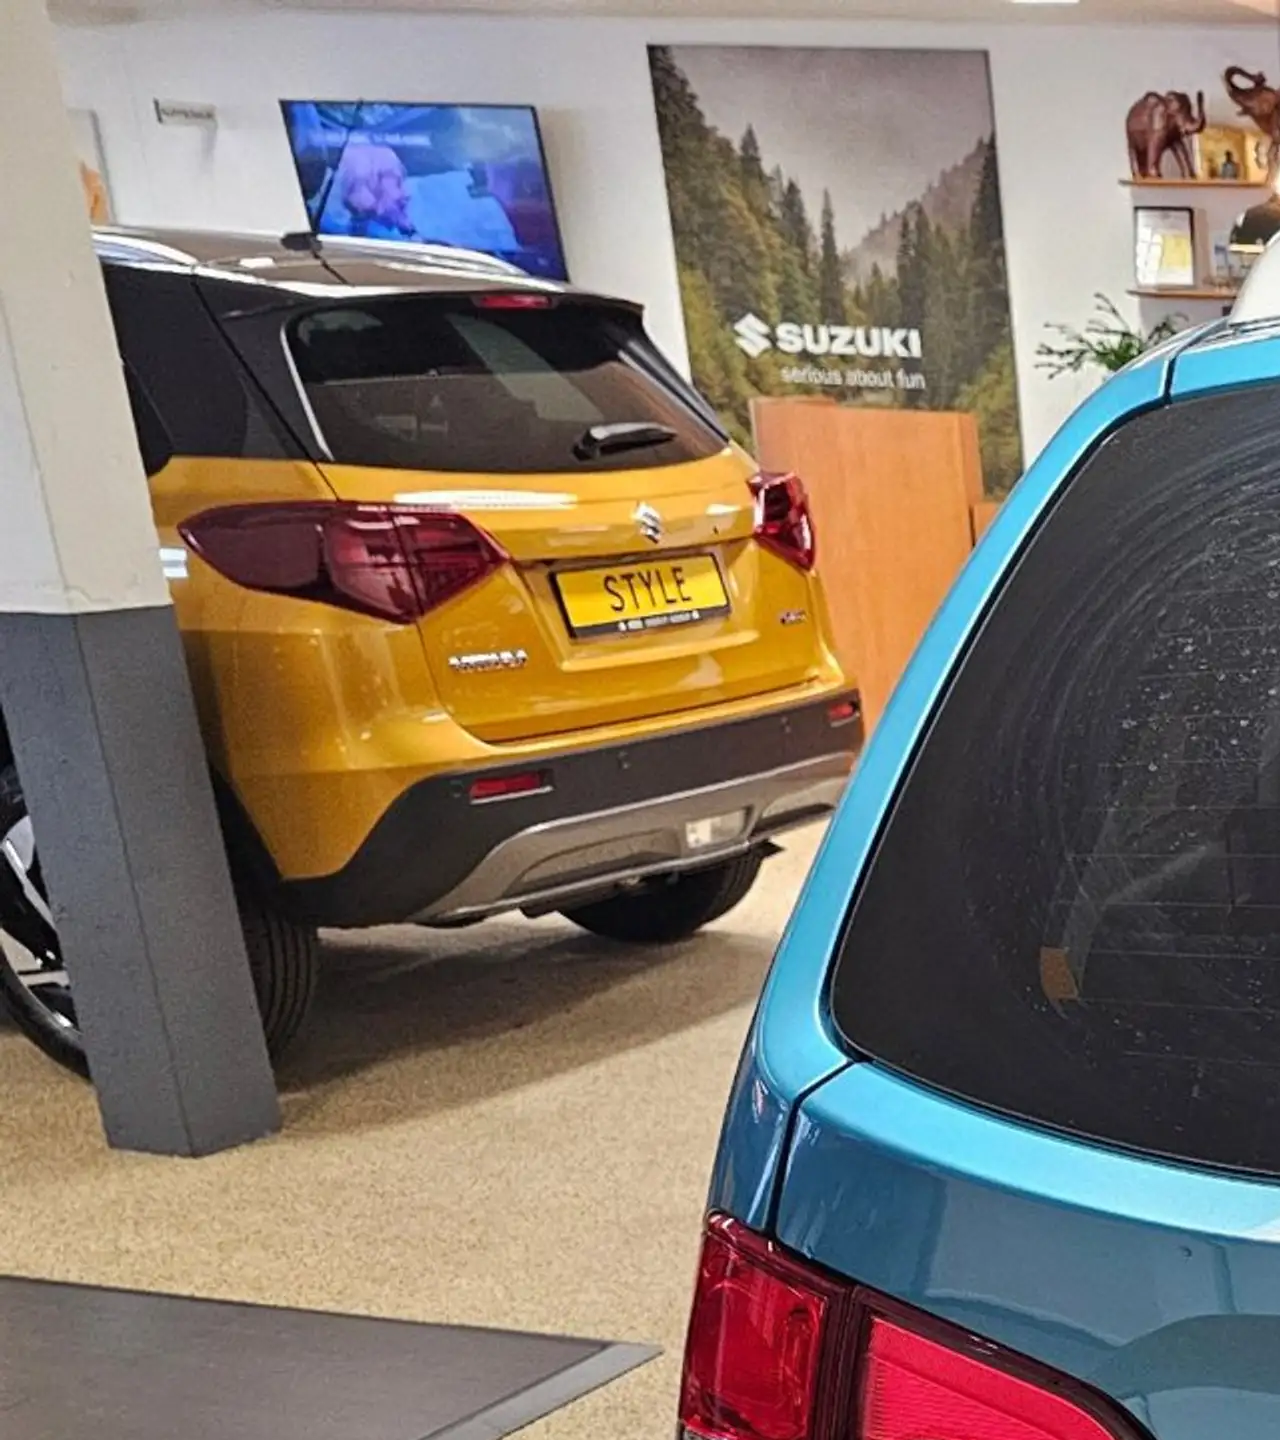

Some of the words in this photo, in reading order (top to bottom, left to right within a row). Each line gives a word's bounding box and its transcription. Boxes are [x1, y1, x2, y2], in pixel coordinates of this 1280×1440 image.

[775, 322, 922, 358] SUZUKI
[781, 364, 842, 386] serious
[846, 367, 893, 388] about
[896, 367, 927, 390] fun
[603, 565, 693, 613] STYLE
